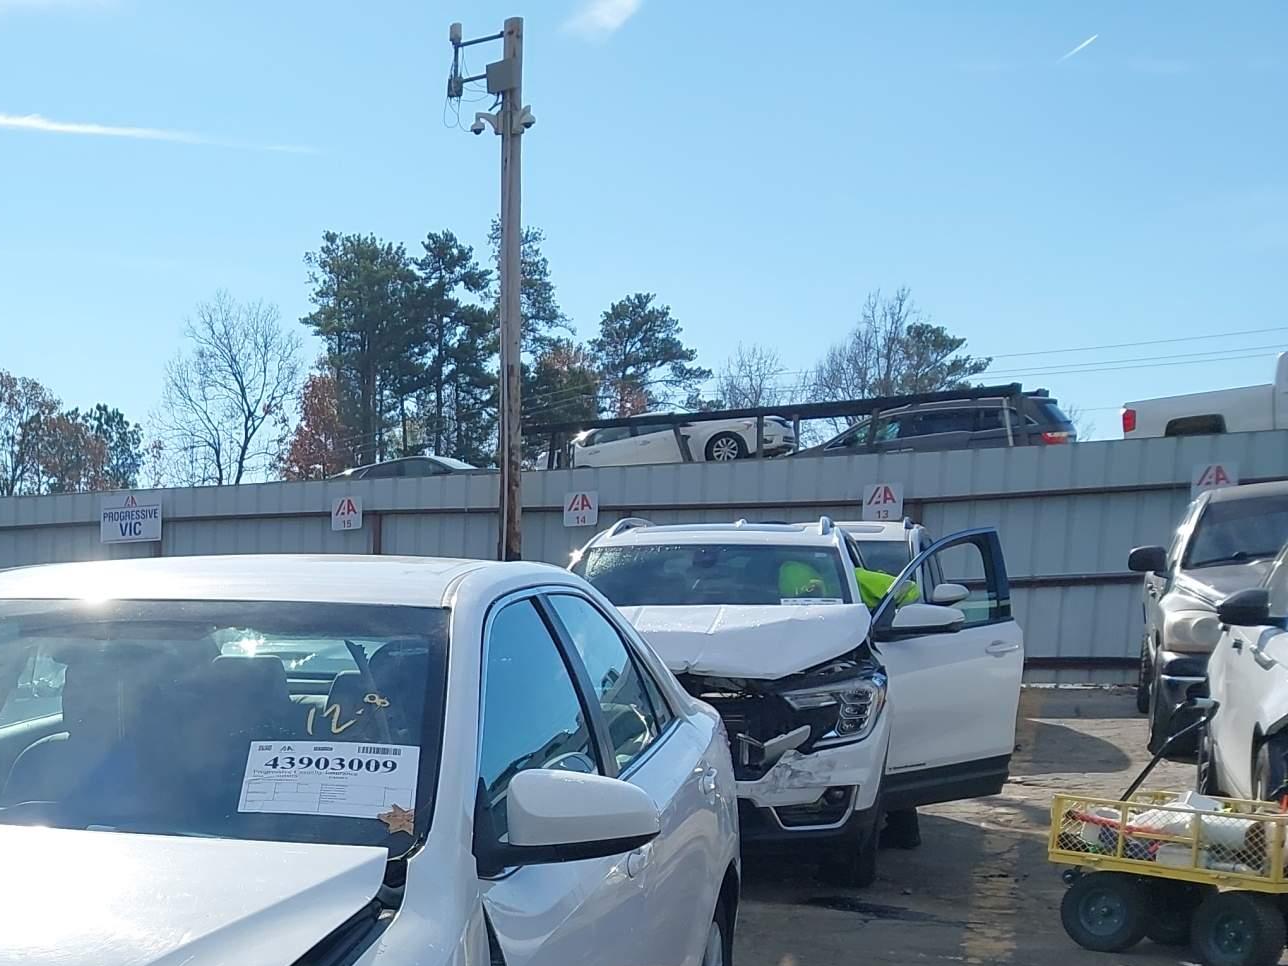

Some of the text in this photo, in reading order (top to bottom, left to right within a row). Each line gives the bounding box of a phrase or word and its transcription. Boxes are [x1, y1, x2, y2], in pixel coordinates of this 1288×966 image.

[103, 508, 159, 522] PROGRESSIVE
[576, 515, 587, 525] 14
[875, 510, 889, 519] 13
[119, 521, 142, 537] VIC
[342, 520, 352, 528] 15
[264, 755, 399, 775] 43903009
